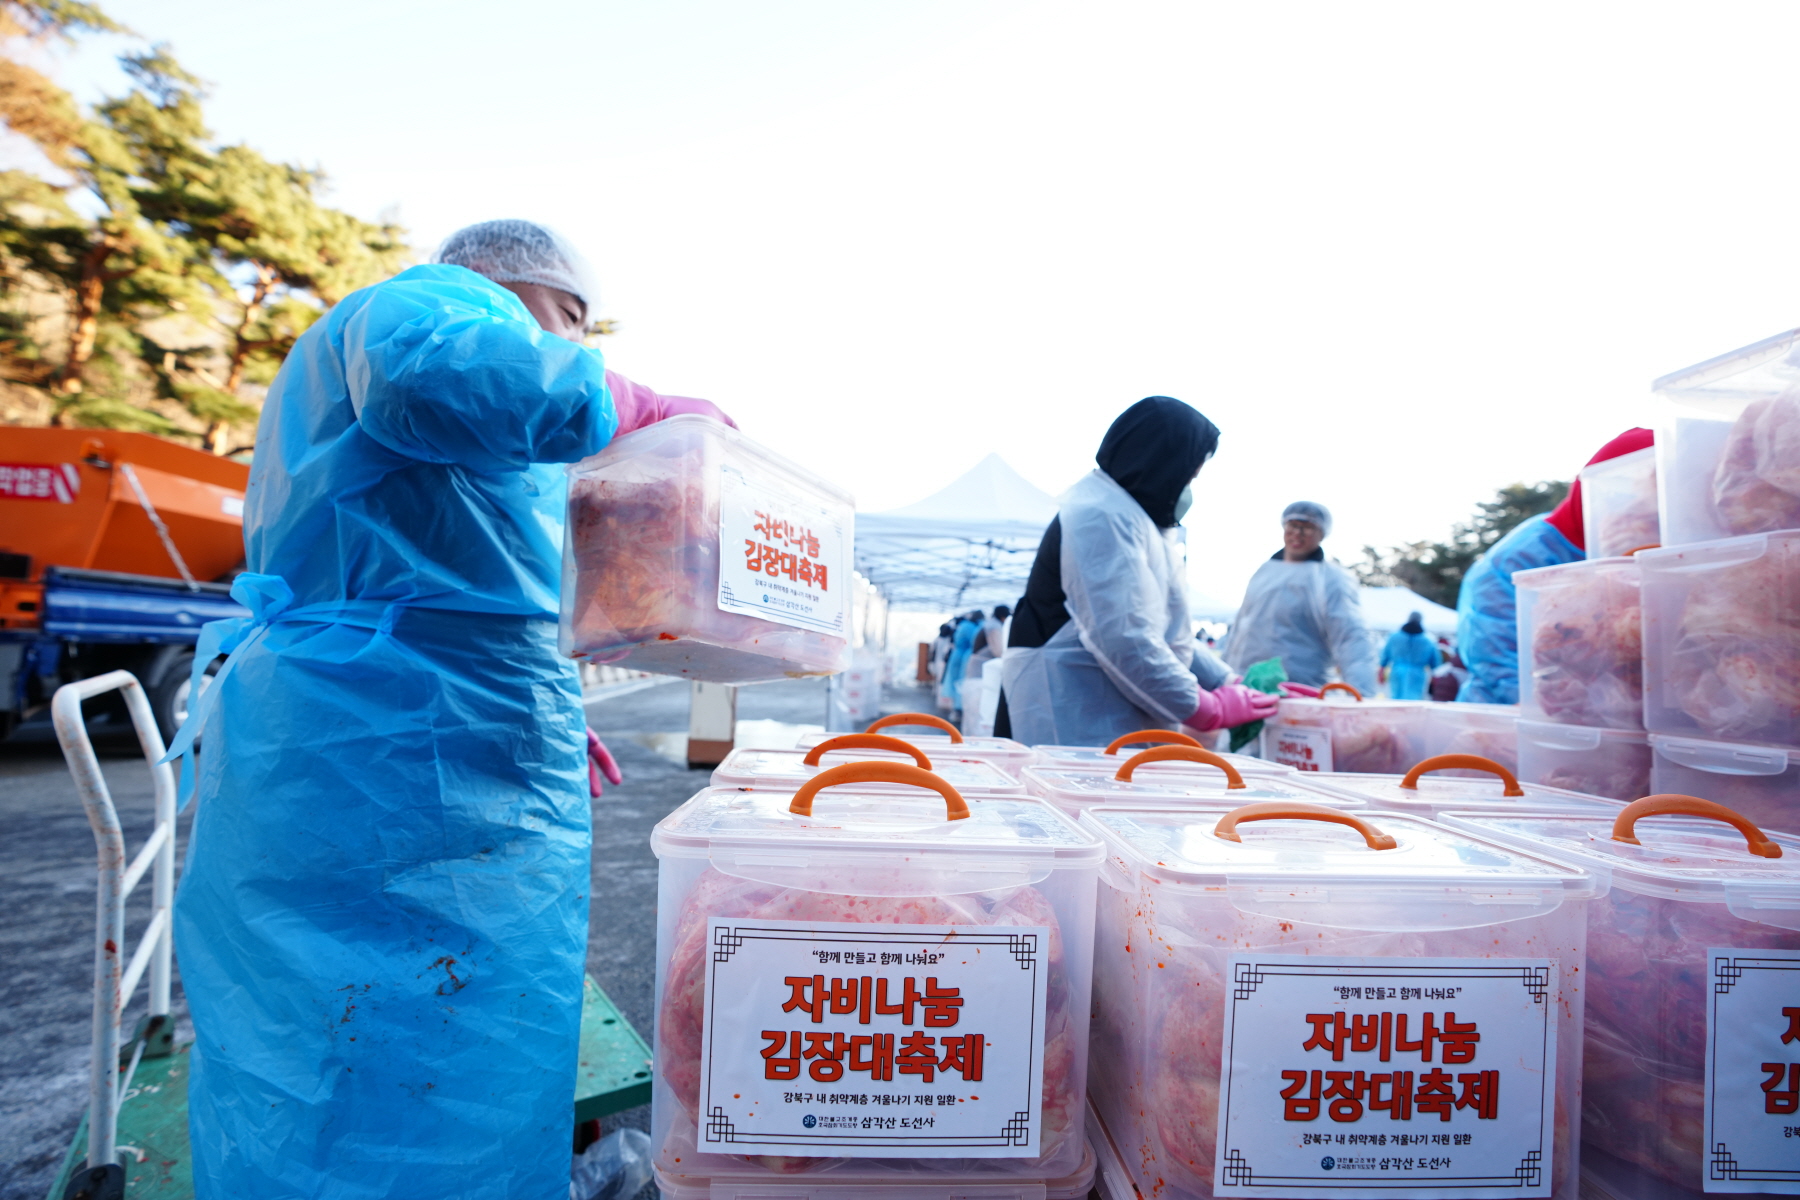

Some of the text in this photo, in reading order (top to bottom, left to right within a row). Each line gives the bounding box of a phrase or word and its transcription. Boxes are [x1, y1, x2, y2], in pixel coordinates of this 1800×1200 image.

[754, 510, 820, 558] 자비나눔
[745, 539, 828, 591] 김장대축제
[844, 951, 877, 965] 만들고
[880, 952, 902, 965] 함께
[781, 974, 965, 1028] 자비나눔
[1364, 986, 1397, 1000] 만들고
[1400, 986, 1422, 1000] 함께
[1302, 1011, 1480, 1064] 자비나눔
[760, 1030, 985, 1083] 김장대축제
[783, 1092, 956, 1106] 강북구 내 취약계층 겨울나기 지원 일환
[1279, 1067, 1499, 1122] 김장대축제
[861, 1116, 936, 1130] 삼각산 도선사
[1302, 1133, 1472, 1146] 강북구 내 취약계층 겨울나기 지원 일환
[1379, 1157, 1452, 1170] 삼각산 도선사
